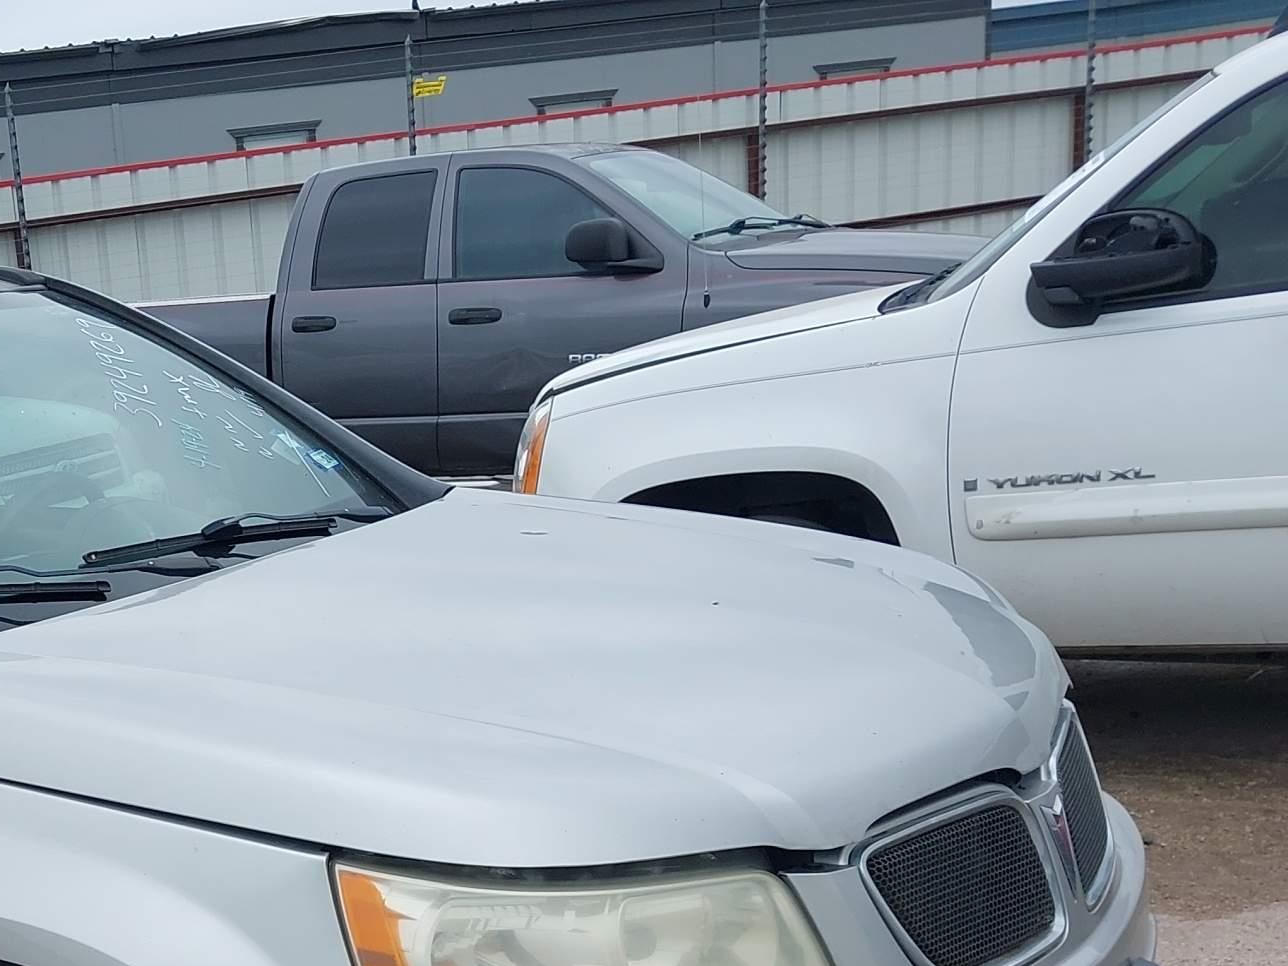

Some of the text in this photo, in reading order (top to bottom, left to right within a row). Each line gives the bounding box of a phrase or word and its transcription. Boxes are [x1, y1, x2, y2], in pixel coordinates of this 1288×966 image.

[75, 318, 163, 427] 39249269
[987, 467, 1157, 489] YUKON XL
